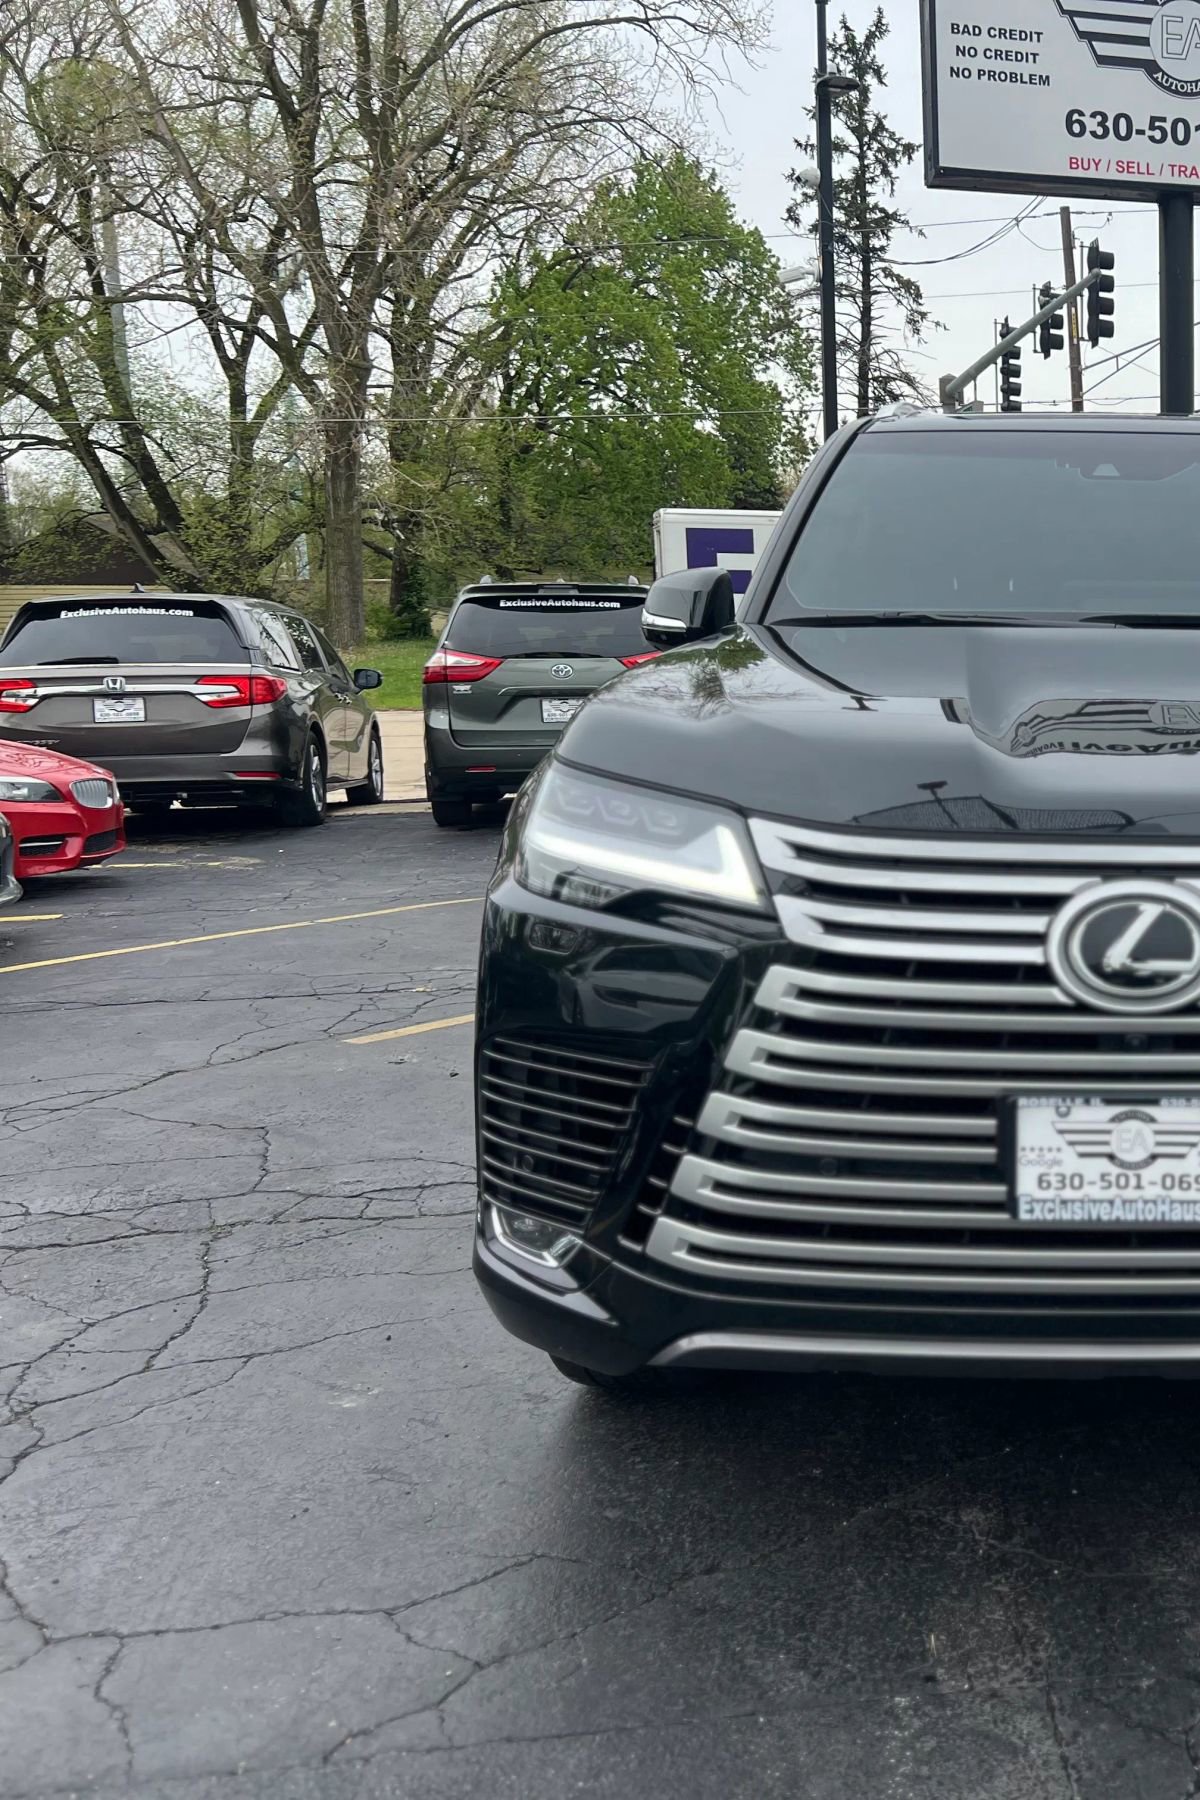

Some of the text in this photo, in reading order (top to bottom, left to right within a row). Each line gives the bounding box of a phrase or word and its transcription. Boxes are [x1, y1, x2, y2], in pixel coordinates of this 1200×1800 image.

[950, 22, 1044, 43] BAD CREDIT
[955, 45, 1039, 64] NO CREDIT
[949, 66, 1050, 86] NO PROBLEM
[1068, 156, 1102, 172] BUY
[1115, 160, 1155, 176] SELL
[60, 606, 194, 619] ExclusiveAutohaus.com
[499, 598, 621, 609] ExclusiveAutohaus.com
